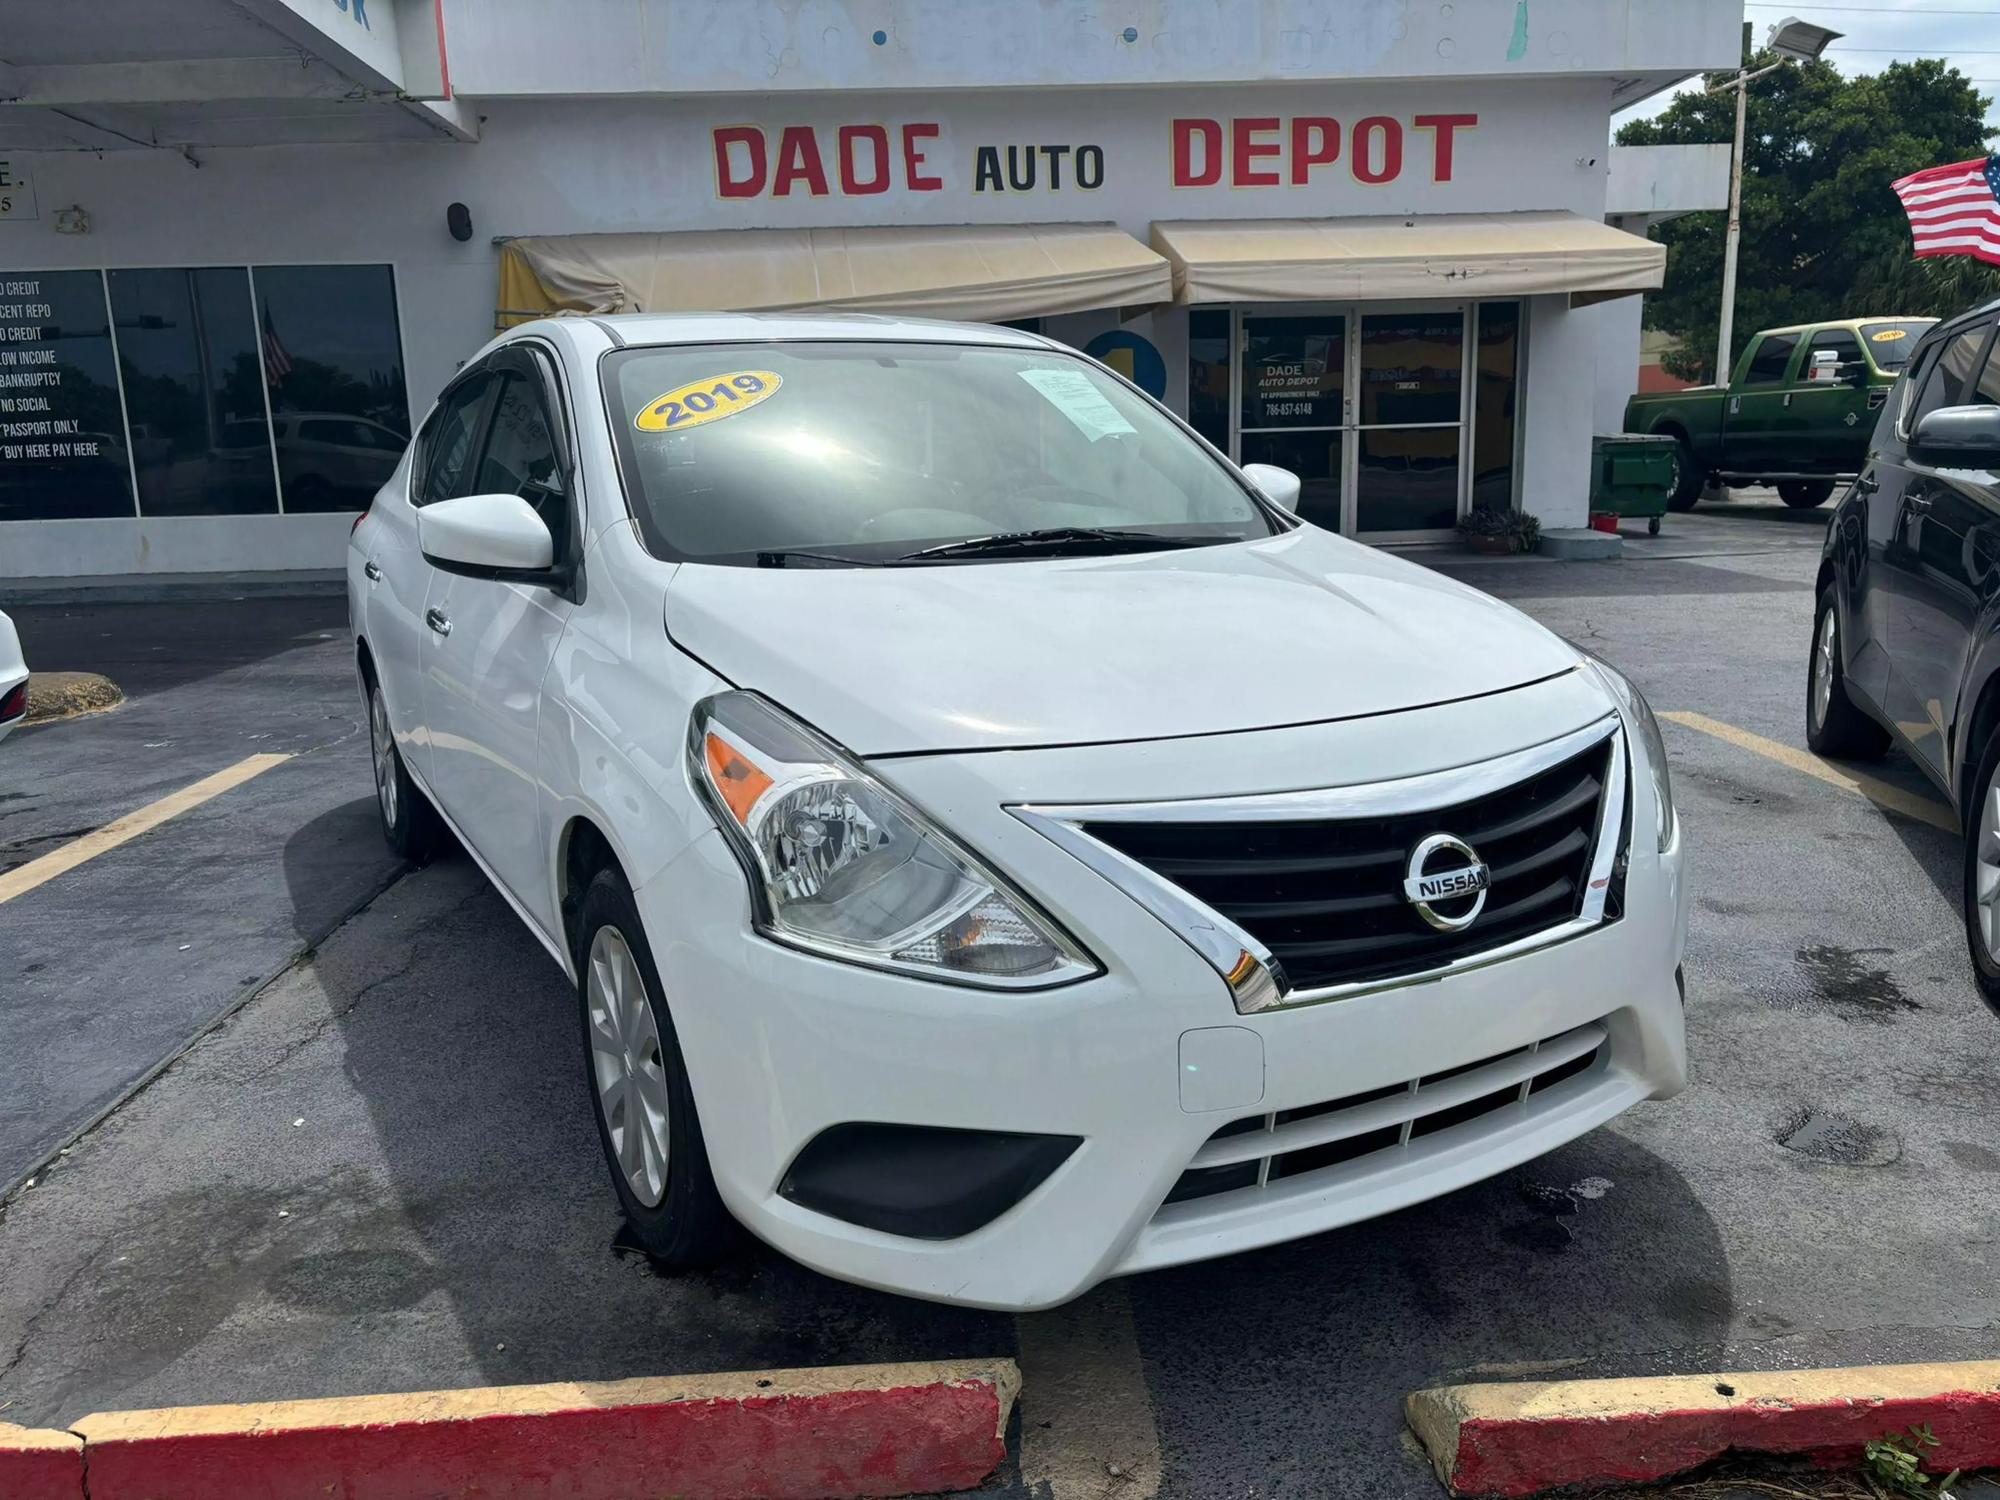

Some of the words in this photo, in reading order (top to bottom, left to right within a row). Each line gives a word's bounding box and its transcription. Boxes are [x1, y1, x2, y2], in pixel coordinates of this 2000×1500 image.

[713, 123, 943, 199] DADE
[975, 144, 1105, 192] AUTO
[1171, 112, 1479, 187] DEPOT
[6, 281, 40, 296] CREDIT
[25, 303, 52, 318] REPO
[8, 326, 41, 341] CREDIT
[19, 350, 57, 365] INCOME
[1266, 365, 1303, 376] DADE
[0, 372, 61, 388] BANKRUPTCY
[1258, 378, 1285, 387] AUTO
[1287, 376, 1320, 386] DEPOT
[1, 398, 15, 413] NO
[17, 397, 51, 412] SOCIAL
[654, 374, 767, 427] 2019
[1266, 402, 1312, 416] 786-857-6148
[3, 421, 52, 437] PASSPORT
[54, 419, 79, 434] ONLY
[5, 444, 24, 459] BUY
[26, 443, 51, 458] HERE
[52, 442, 71, 457] PAY
[73, 442, 99, 456] HERE
[1419, 870, 1488, 897] NISSAN
